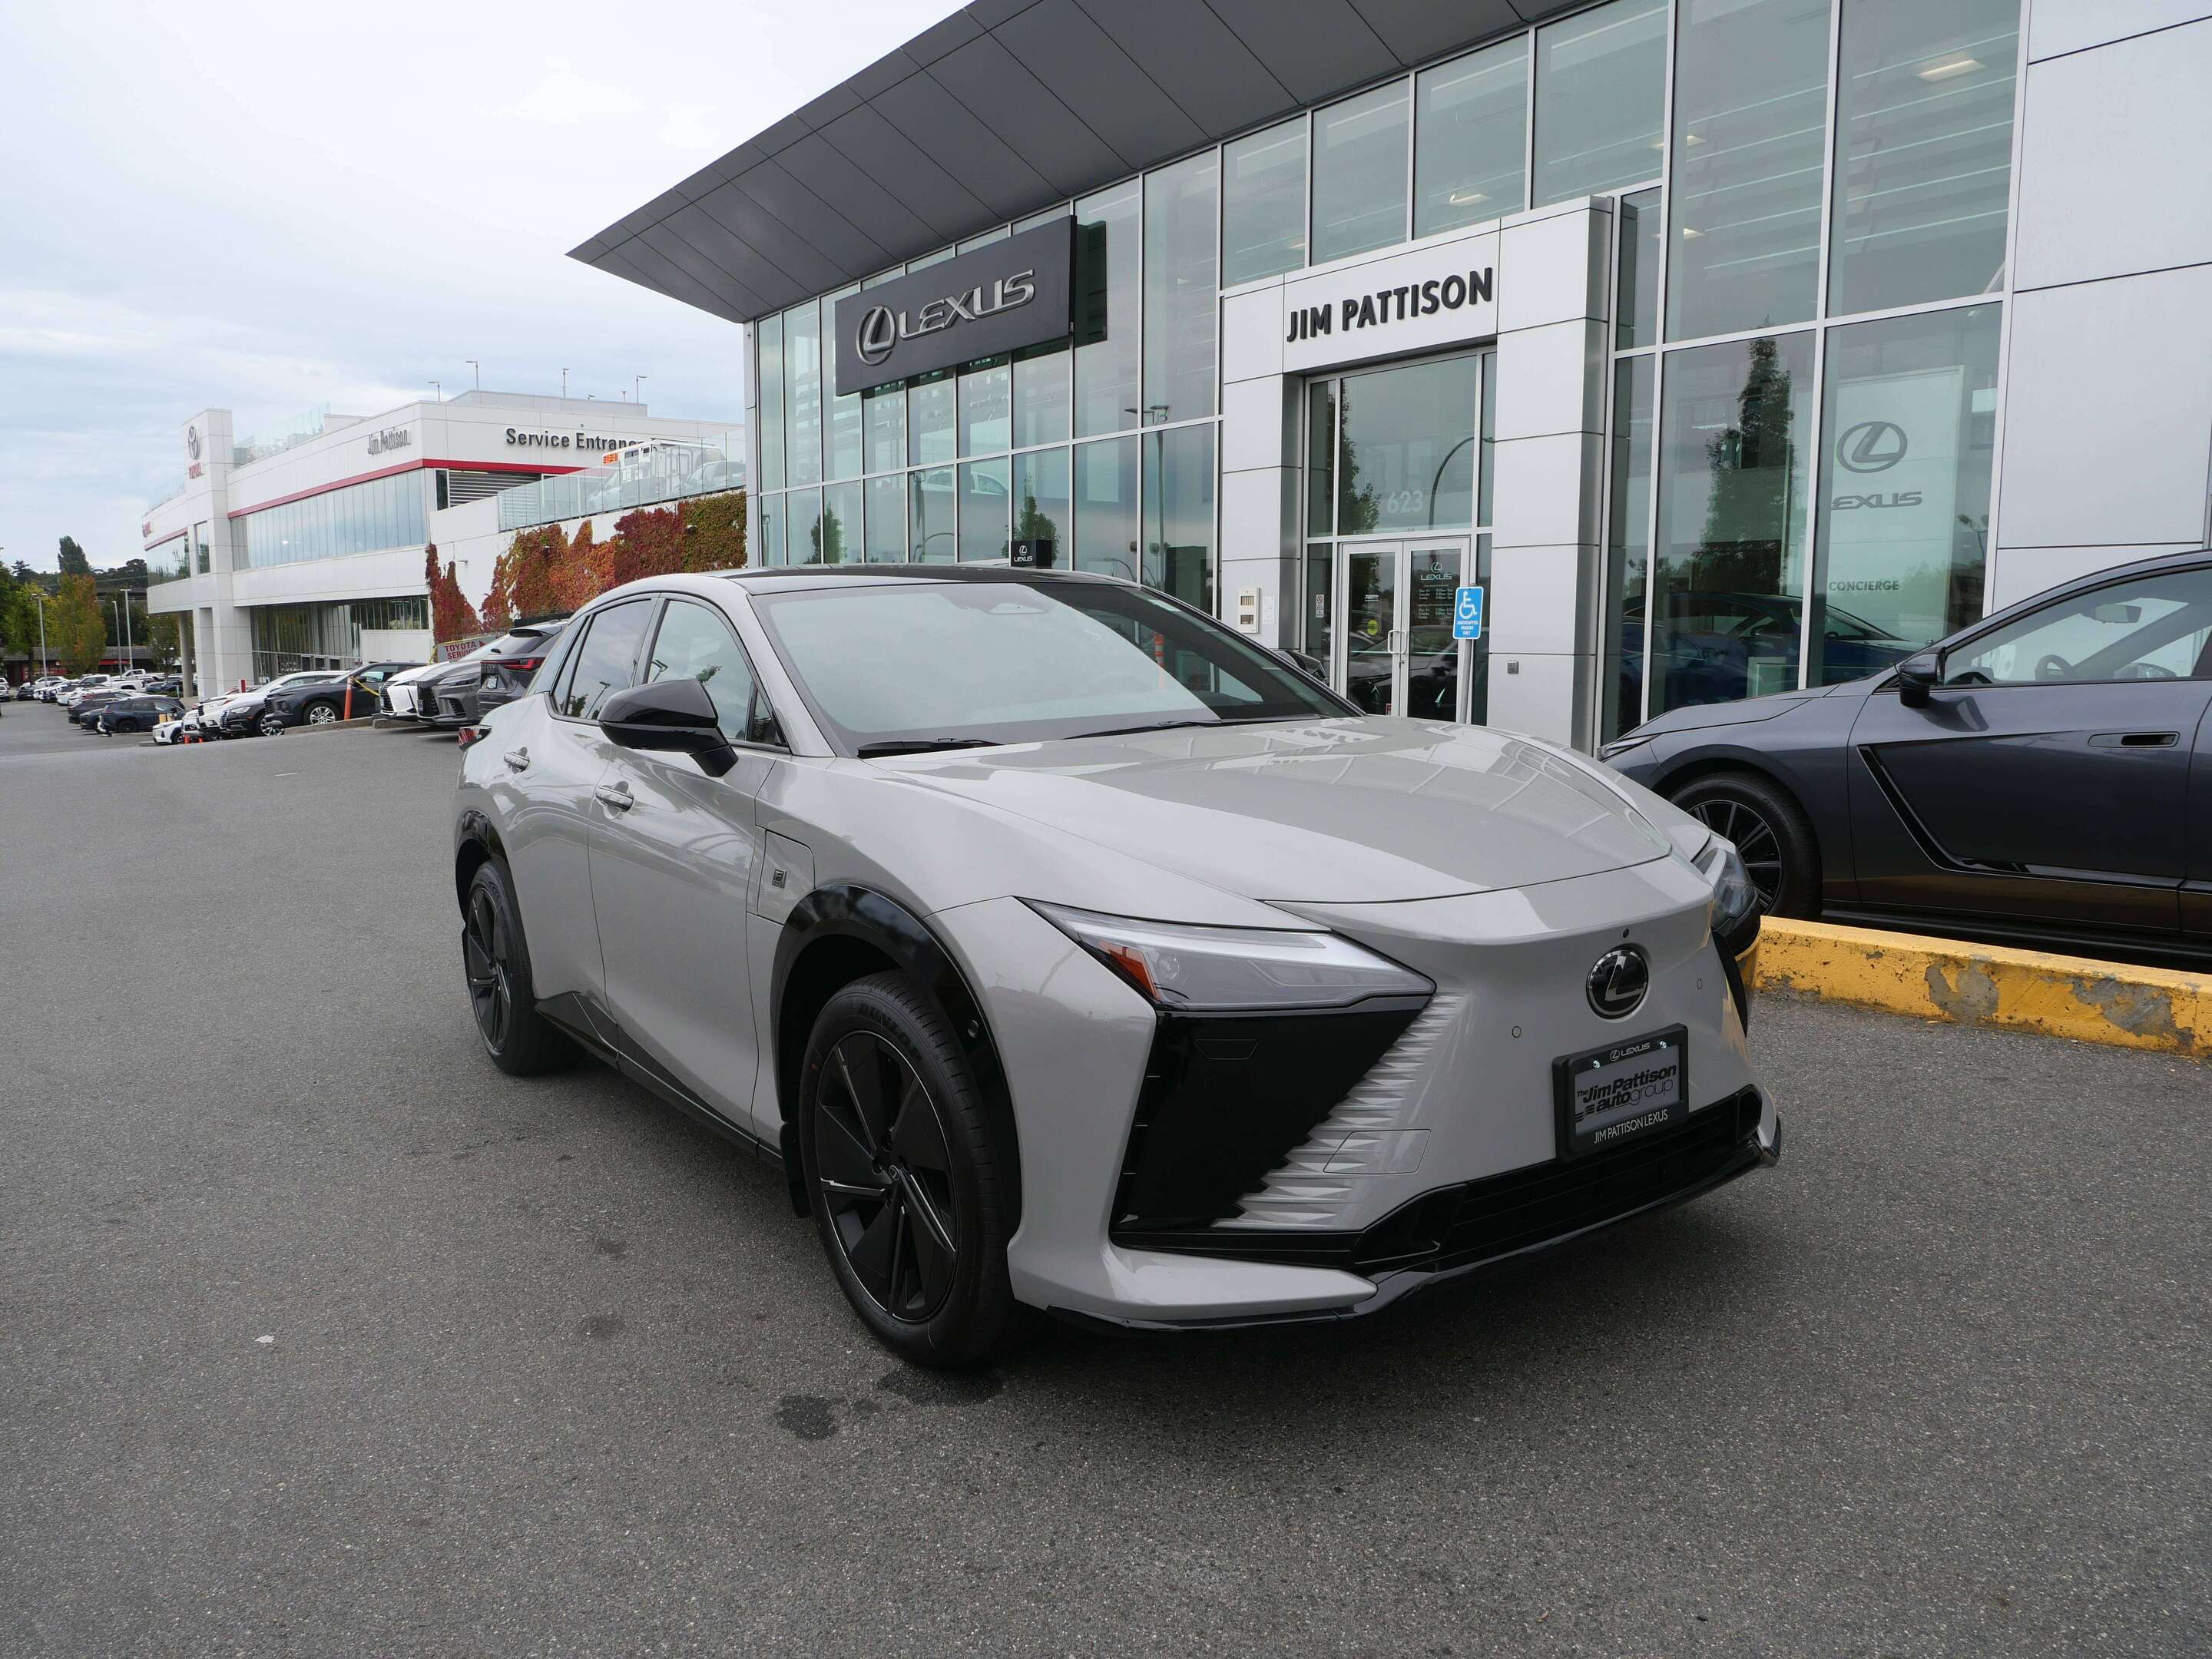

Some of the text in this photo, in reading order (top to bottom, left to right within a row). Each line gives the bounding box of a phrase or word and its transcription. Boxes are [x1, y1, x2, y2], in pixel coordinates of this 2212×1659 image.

[899, 269, 1035, 340] LEXUS
[1286, 267, 1493, 343] JIM PATTISON
[505, 428, 644, 451] Service Entran
[1388, 490, 1423, 515] 623
[1831, 491, 1922, 511] EXUS
[1829, 581, 1899, 591] CONCIERGE
[444, 641, 477, 652] TOYOTA
[447, 649, 476, 660] SERVIC
[1621, 1042, 1651, 1057] LEXUS
[1582, 1084, 1612, 1104] Jim
[1611, 1065, 1677, 1094] Pattison
[1594, 1109, 1668, 1144] JIM PATTISON LEXUS
